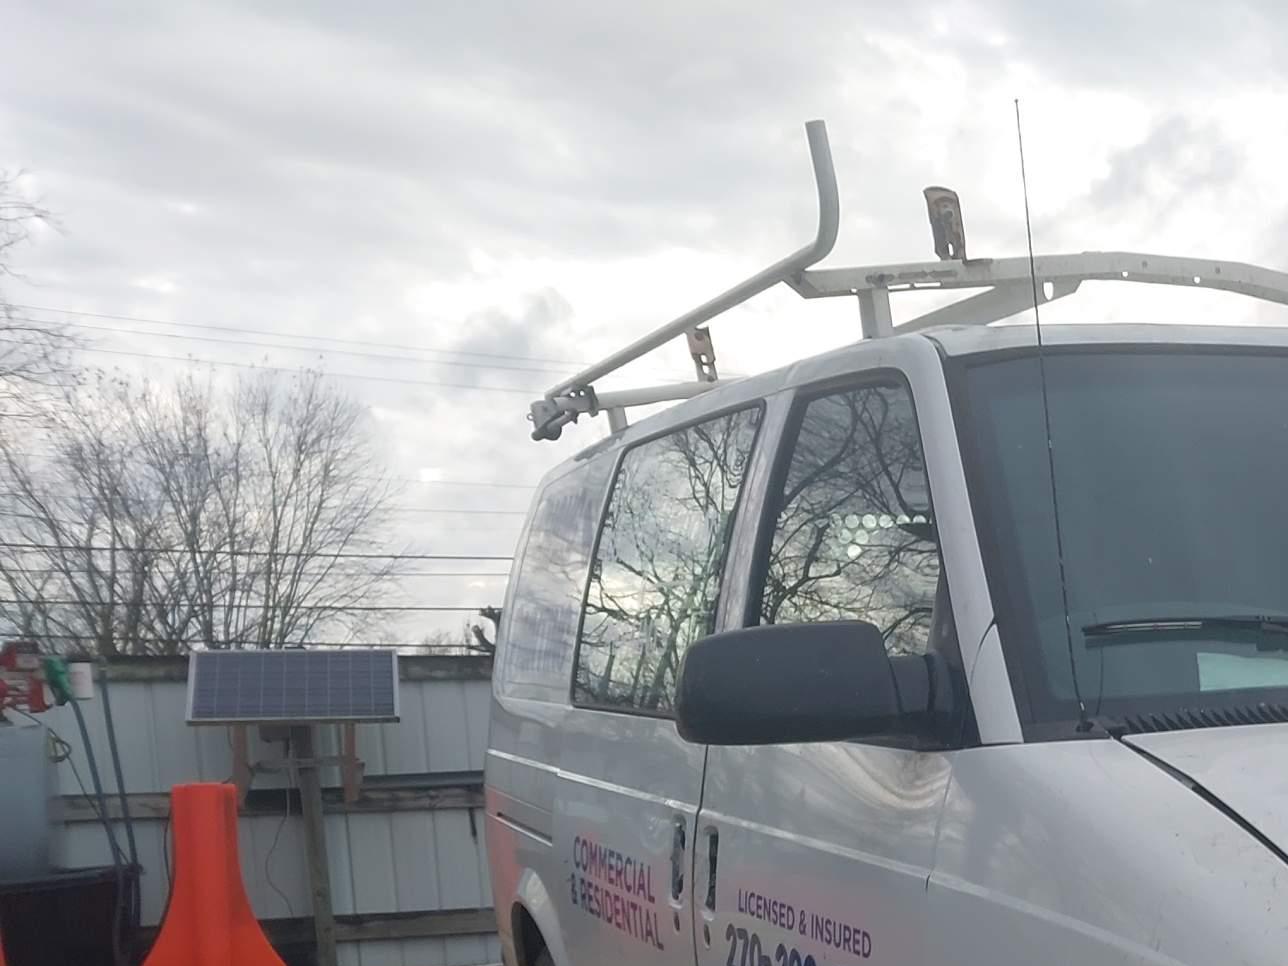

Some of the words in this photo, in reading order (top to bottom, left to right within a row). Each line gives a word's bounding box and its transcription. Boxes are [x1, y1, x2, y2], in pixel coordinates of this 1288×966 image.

[574, 836, 655, 904] COMMERCIAL
[580, 878, 664, 951] RESIDENTIAL
[738, 888, 795, 931] LICENSED
[799, 910, 807, 936] &
[811, 913, 872, 959] INSURED
